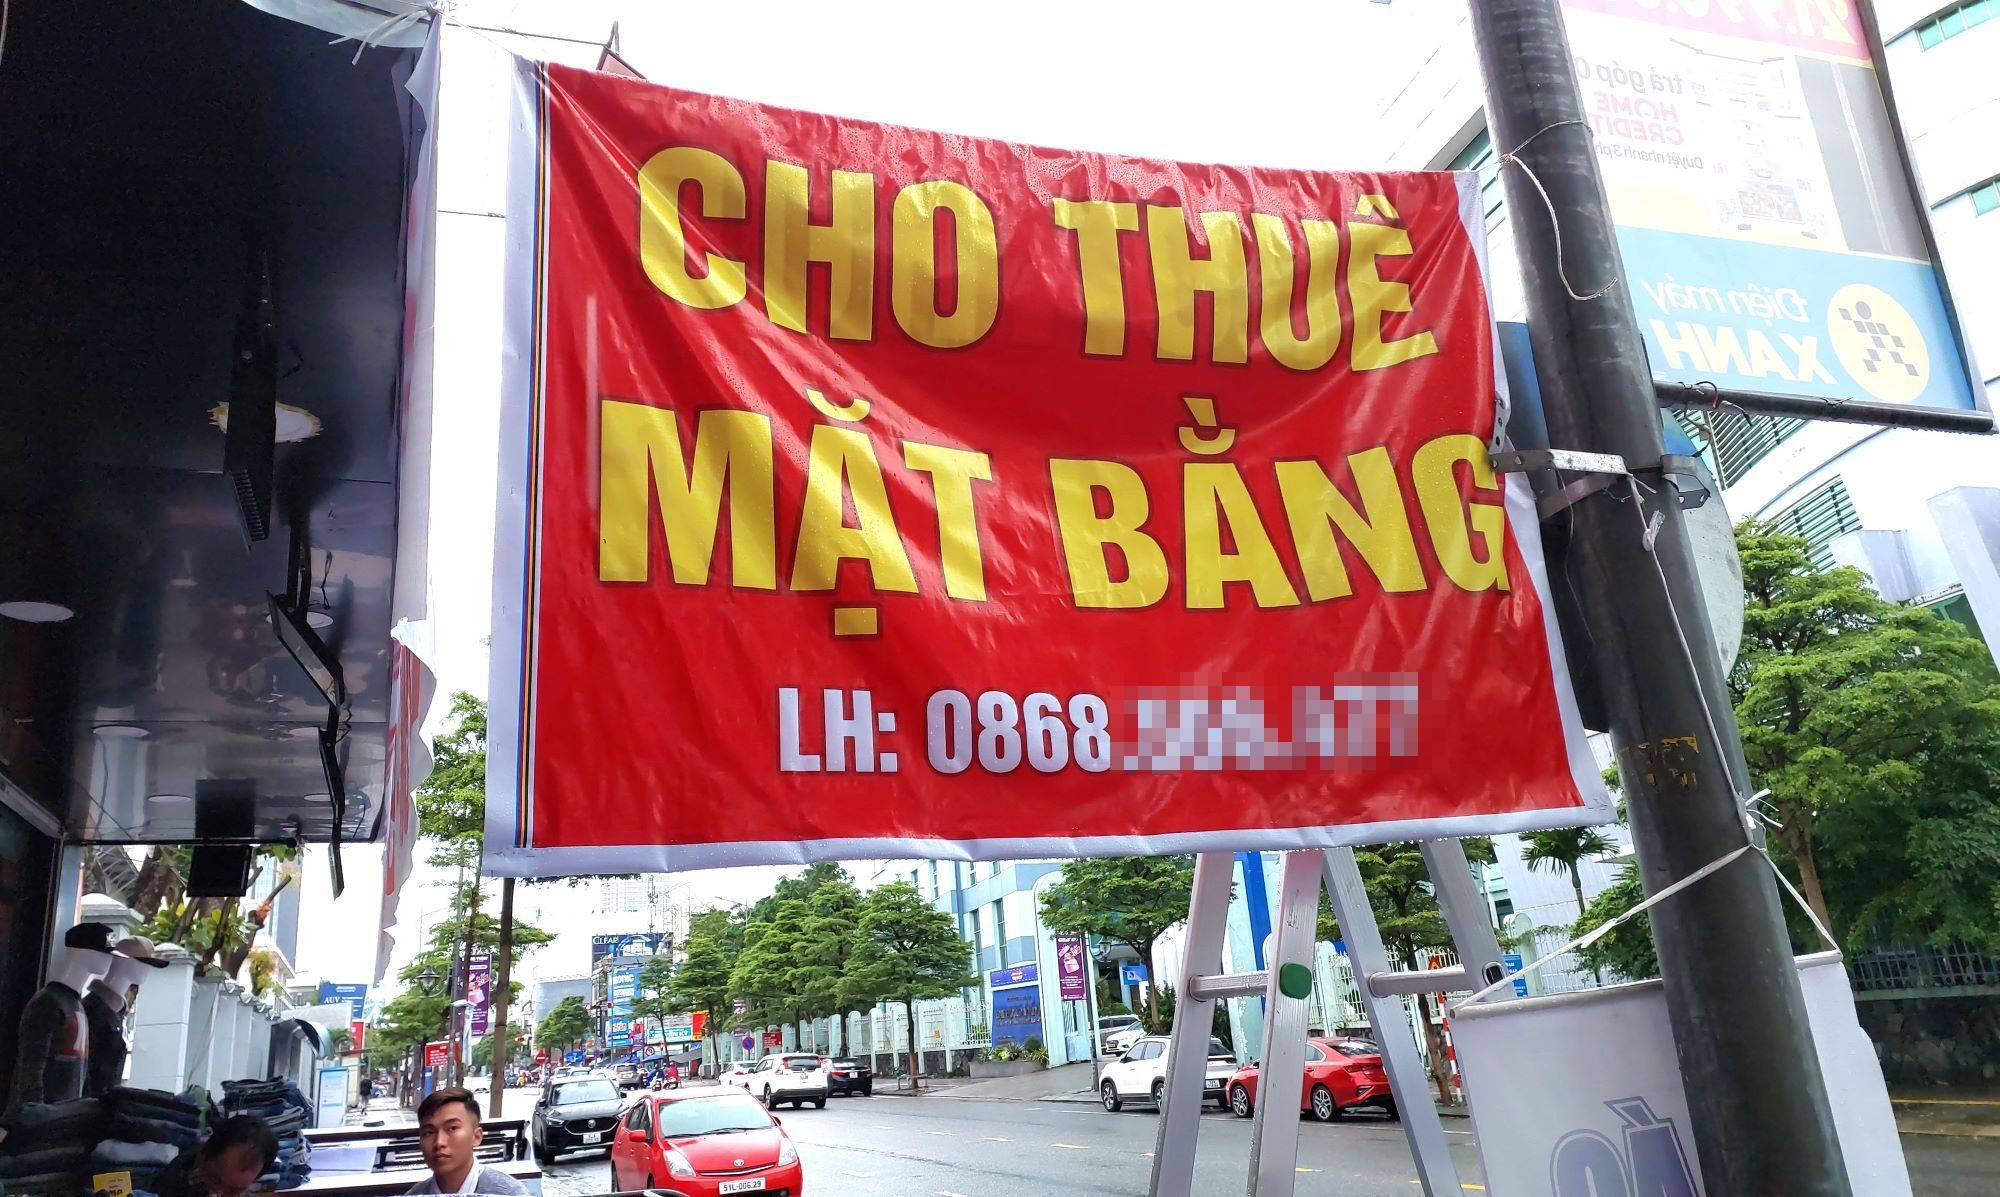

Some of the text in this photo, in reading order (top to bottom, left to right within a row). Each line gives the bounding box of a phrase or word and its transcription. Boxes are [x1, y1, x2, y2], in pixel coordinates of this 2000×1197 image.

[637, 147, 1439, 372] CHO THUÊ
[599, 388, 1510, 636] MẶT BẰNG
[778, 687, 898, 773] LH:
[723, 1181, 762, 1192] 51L-006.29
